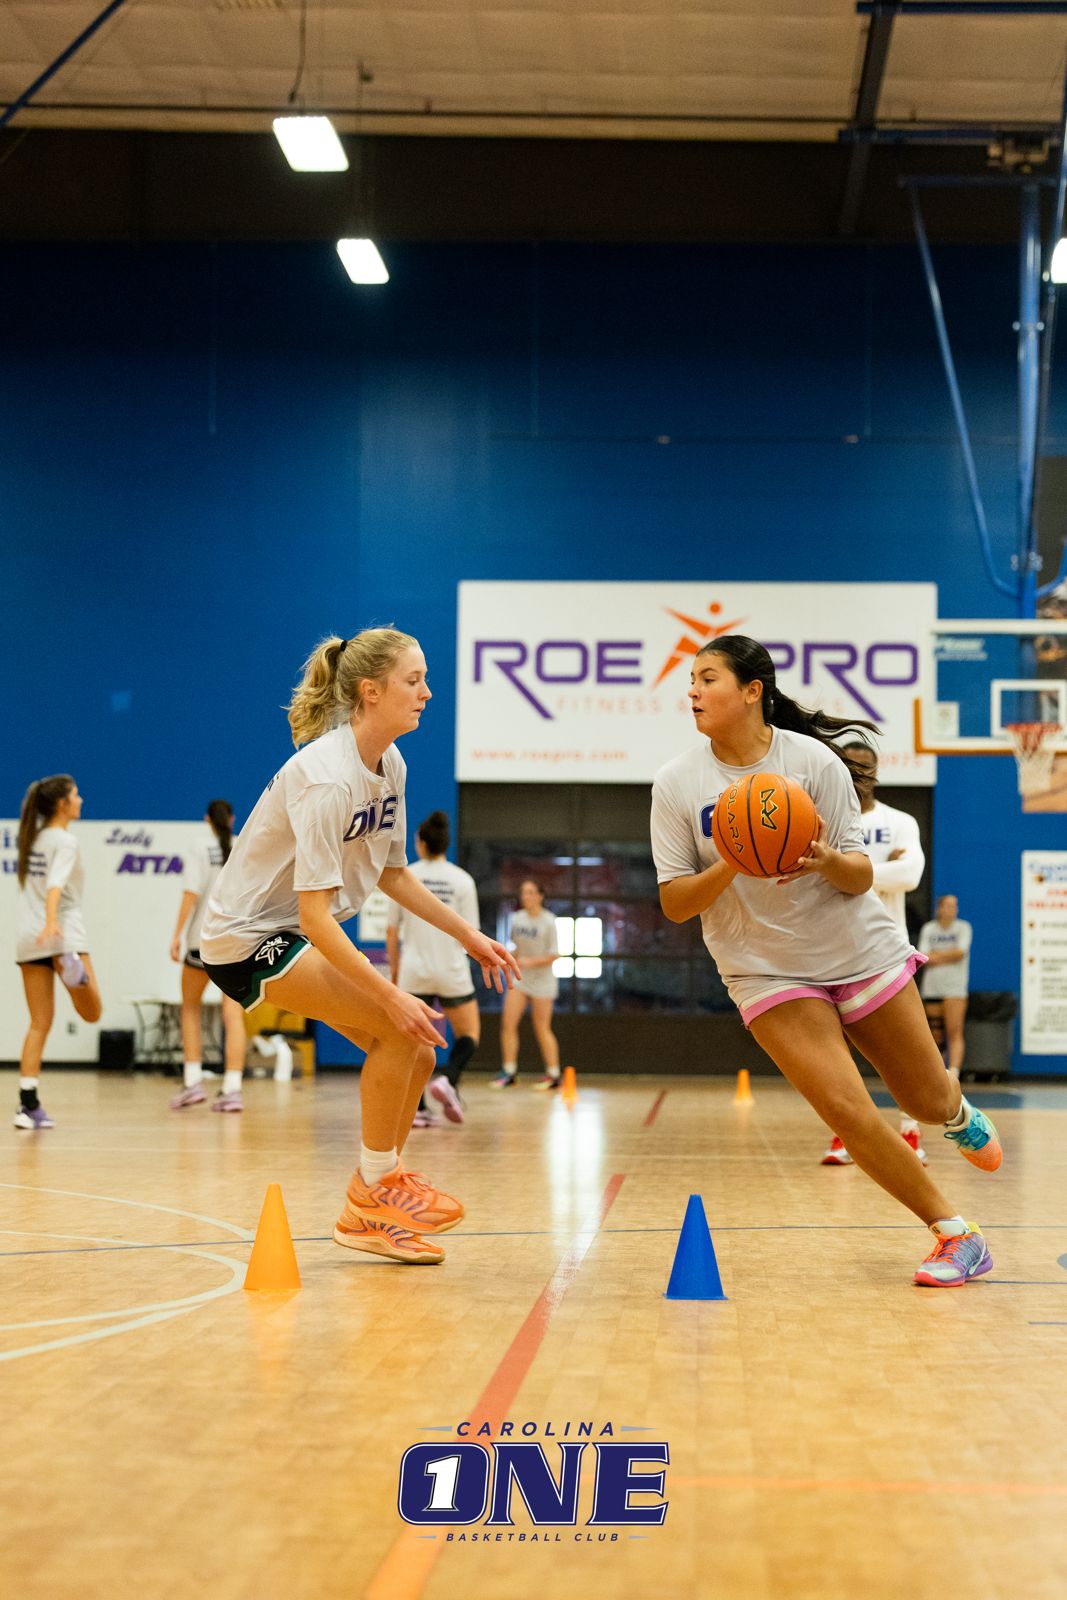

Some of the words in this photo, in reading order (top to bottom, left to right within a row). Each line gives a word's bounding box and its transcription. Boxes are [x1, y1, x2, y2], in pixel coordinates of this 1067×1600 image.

[473, 640, 643, 721] ROE
[106, 828, 153, 847] Lady
[863, 827, 891, 845] NE
